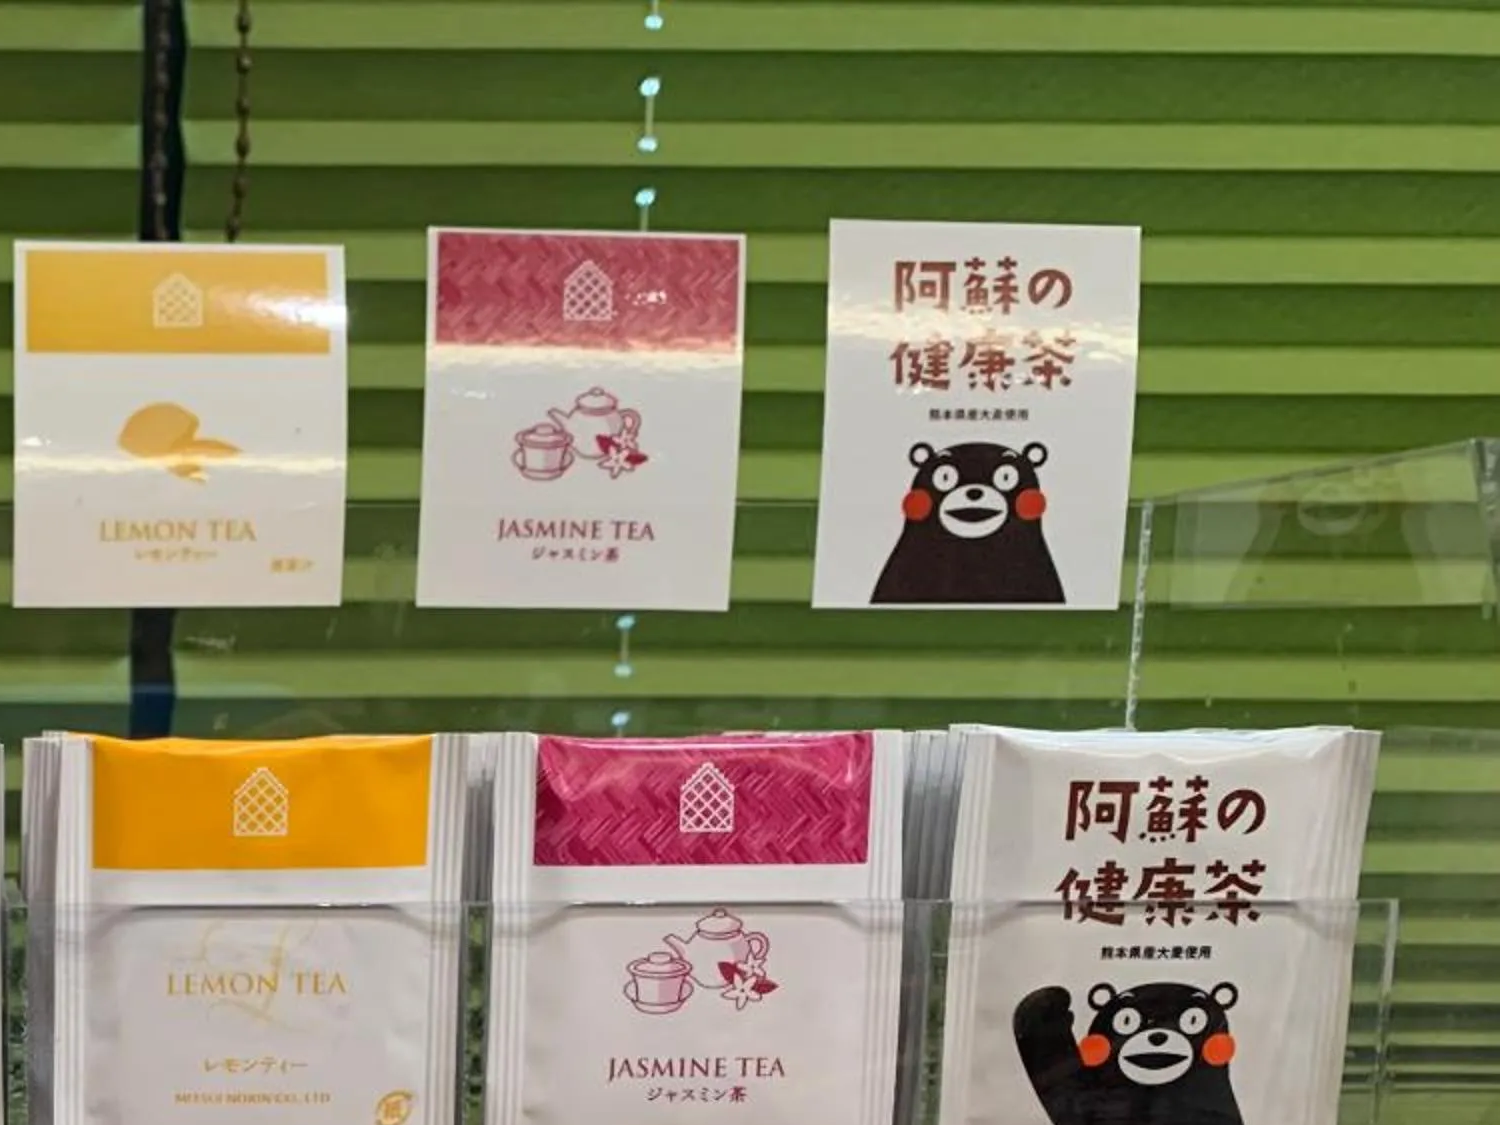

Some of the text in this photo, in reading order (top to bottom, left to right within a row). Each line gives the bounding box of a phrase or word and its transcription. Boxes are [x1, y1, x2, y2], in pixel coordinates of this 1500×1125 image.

[894, 256, 1073, 315] 阿蘇の
[890, 328, 1077, 391] 健康茶
[100, 519, 257, 542] LEMON TEA
[497, 518, 655, 541] JASMINE TEA
[1065, 775, 1267, 843] 阿蘇の
[1054, 857, 1267, 928] 健康茶
[166, 971, 349, 996] LEMON TEA
[203, 1056, 308, 1074] レモンティー
[608, 1057, 785, 1081] JASMINE TEA
[647, 1086, 747, 1103] ジャスミン茶
